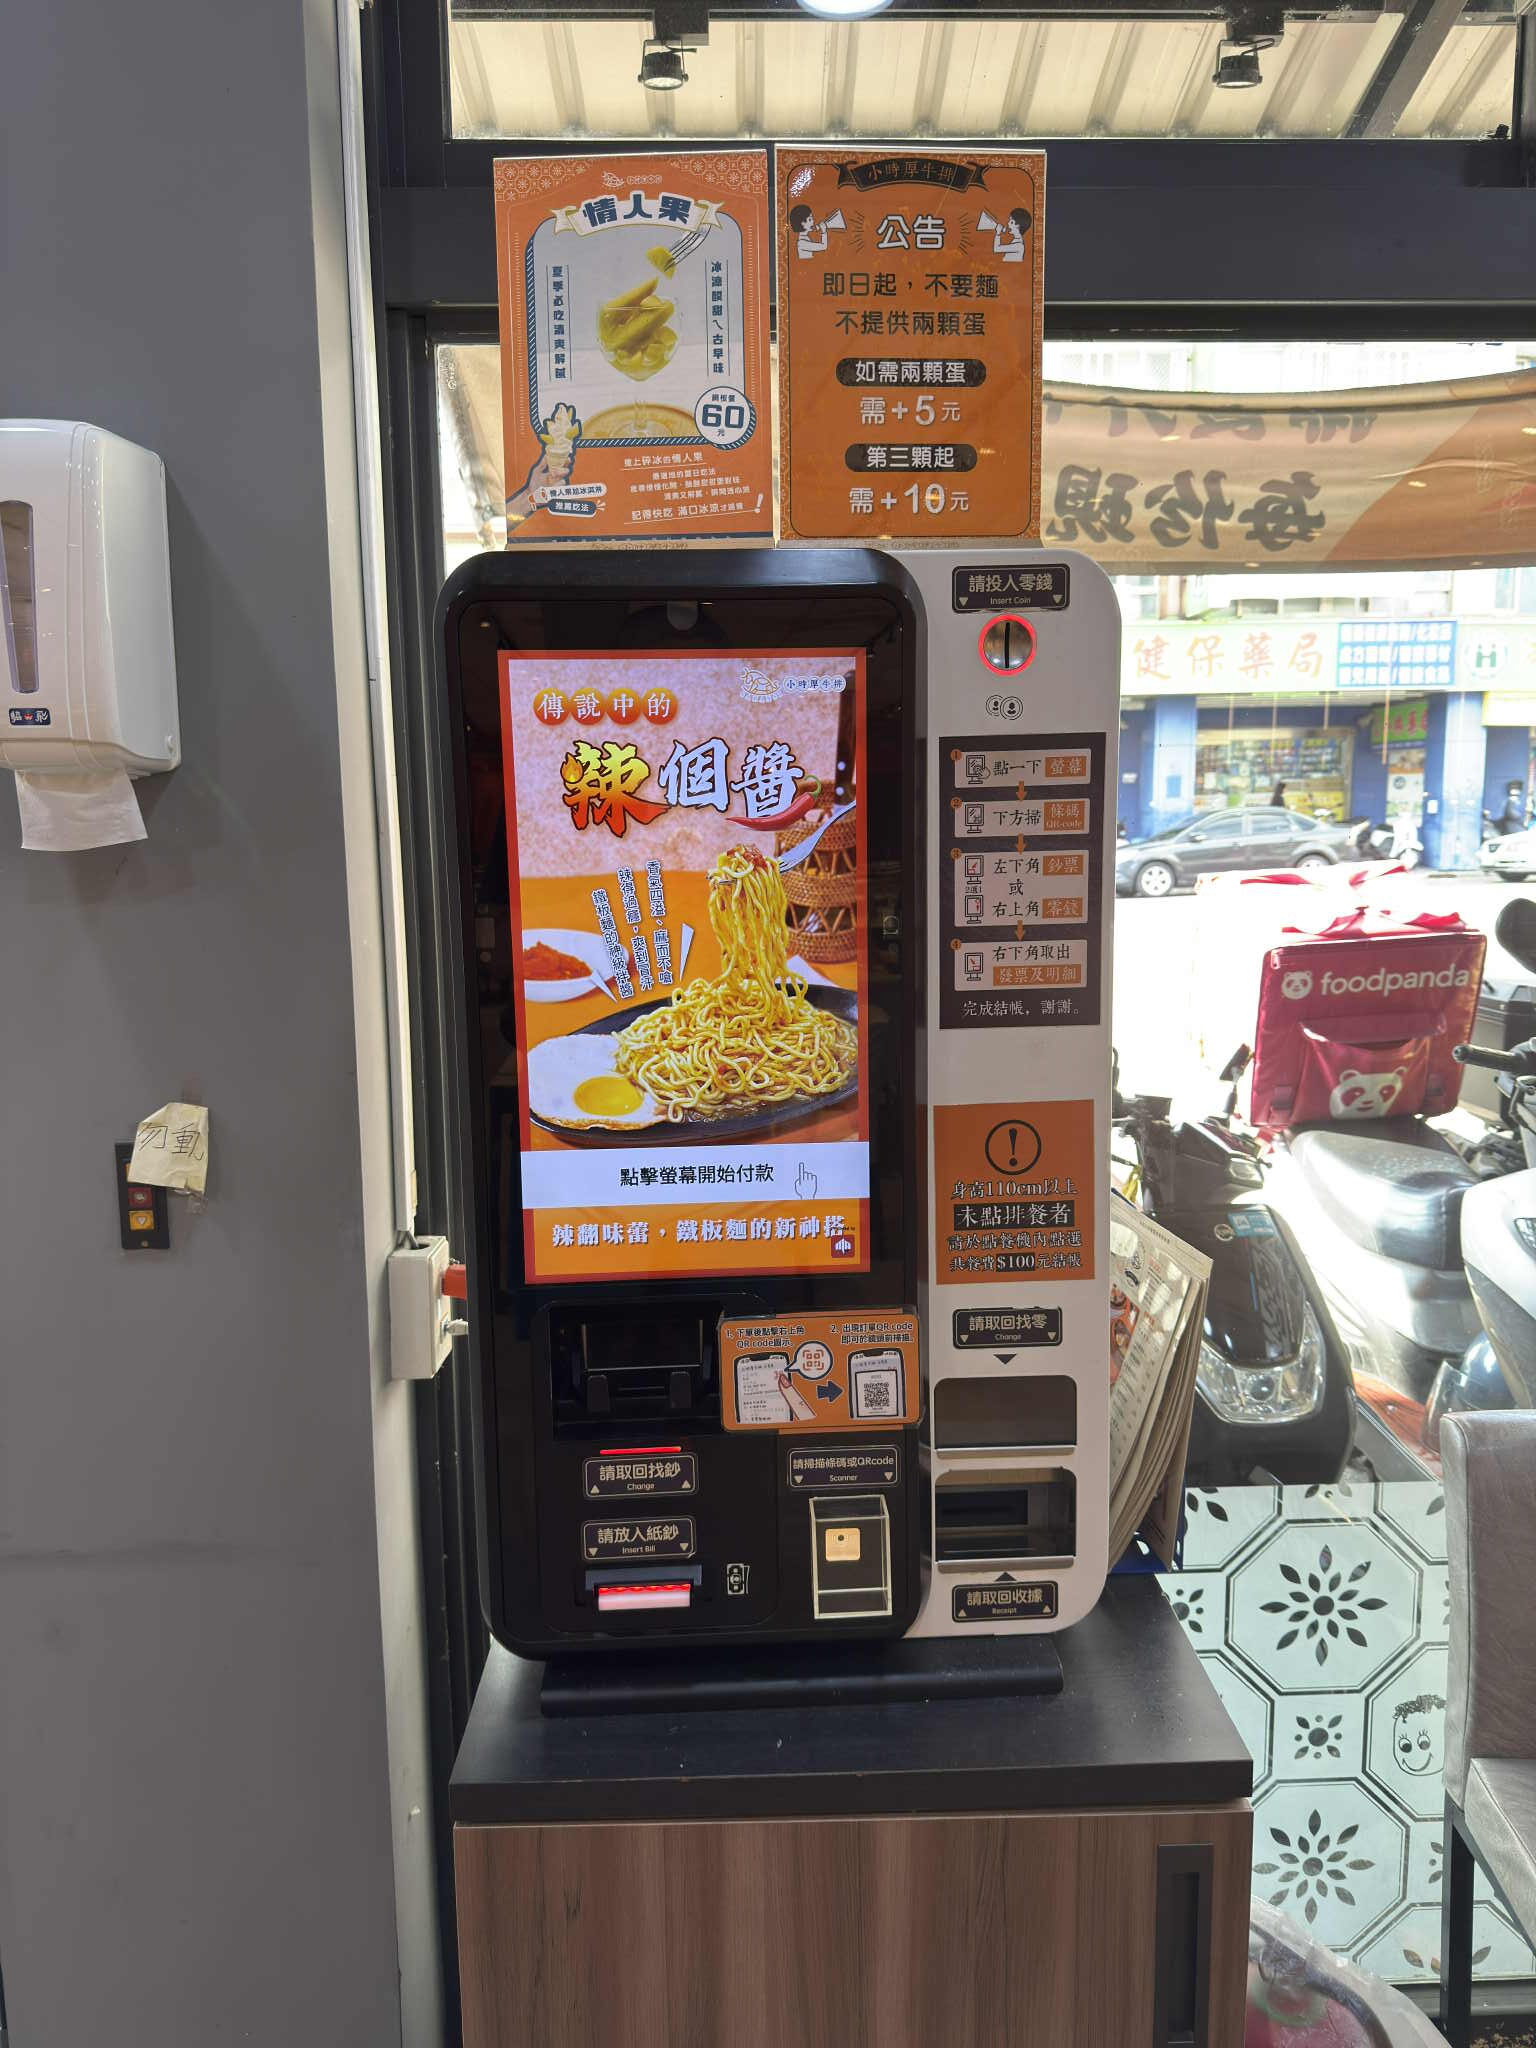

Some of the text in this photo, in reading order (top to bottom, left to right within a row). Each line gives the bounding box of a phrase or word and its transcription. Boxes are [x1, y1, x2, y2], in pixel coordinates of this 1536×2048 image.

[583, 194, 691, 227] 情人果
[876, 215, 946, 249] 公告
[822, 272, 999, 298] 即日起，不要麵
[834, 311, 985, 336] 不提供兩顆蛋
[855, 360, 966, 384] 如需兩顆蛋
[702, 404, 744, 428] 60
[867, 447, 954, 468] 第三顆起
[969, 573, 1053, 593] 請投入零錢
[990, 596, 1031, 605] Insert Coin
[1133, 631, 1323, 680] 健保藥局
[786, 678, 843, 689] 小時厚牛排
[540, 693, 671, 719] 傳說中的
[993, 760, 1041, 777] 點一下
[560, 737, 805, 838] 辣個醬
[993, 803, 1080, 826] 下方掃 條碼
[994, 856, 1079, 875] 左下角 鈔票
[1009, 879, 1024, 896] 或
[992, 901, 1080, 918] 右上角 零錢
[992, 944, 1070, 962] 右下角取出
[999, 967, 1077, 983] 發票及明細
[1321, 963, 1471, 997] foodpanda
[138, 1123, 205, 1161] 勿動
[620, 1163, 774, 1187] 點擊螢幕開始付款
[951, 1178, 1078, 1199] 身高110cm以上
[956, 1203, 1070, 1228] 未點排餐者
[947, 1230, 1082, 1252] 請於點餐機內點選
[892, 1322, 912, 1331] code
[969, 1314, 1048, 1332] 請取回找零
[994, 1333, 1021, 1341] Change
[599, 1462, 681, 1481] 請取回找鈔
[829, 1474, 858, 1482] Scanner
[627, 1483, 655, 1491] Change
[598, 1525, 679, 1544] 請放入紙鈔
[644, 1545, 656, 1553] Bill
[966, 1588, 1043, 1606] 請取回收據
